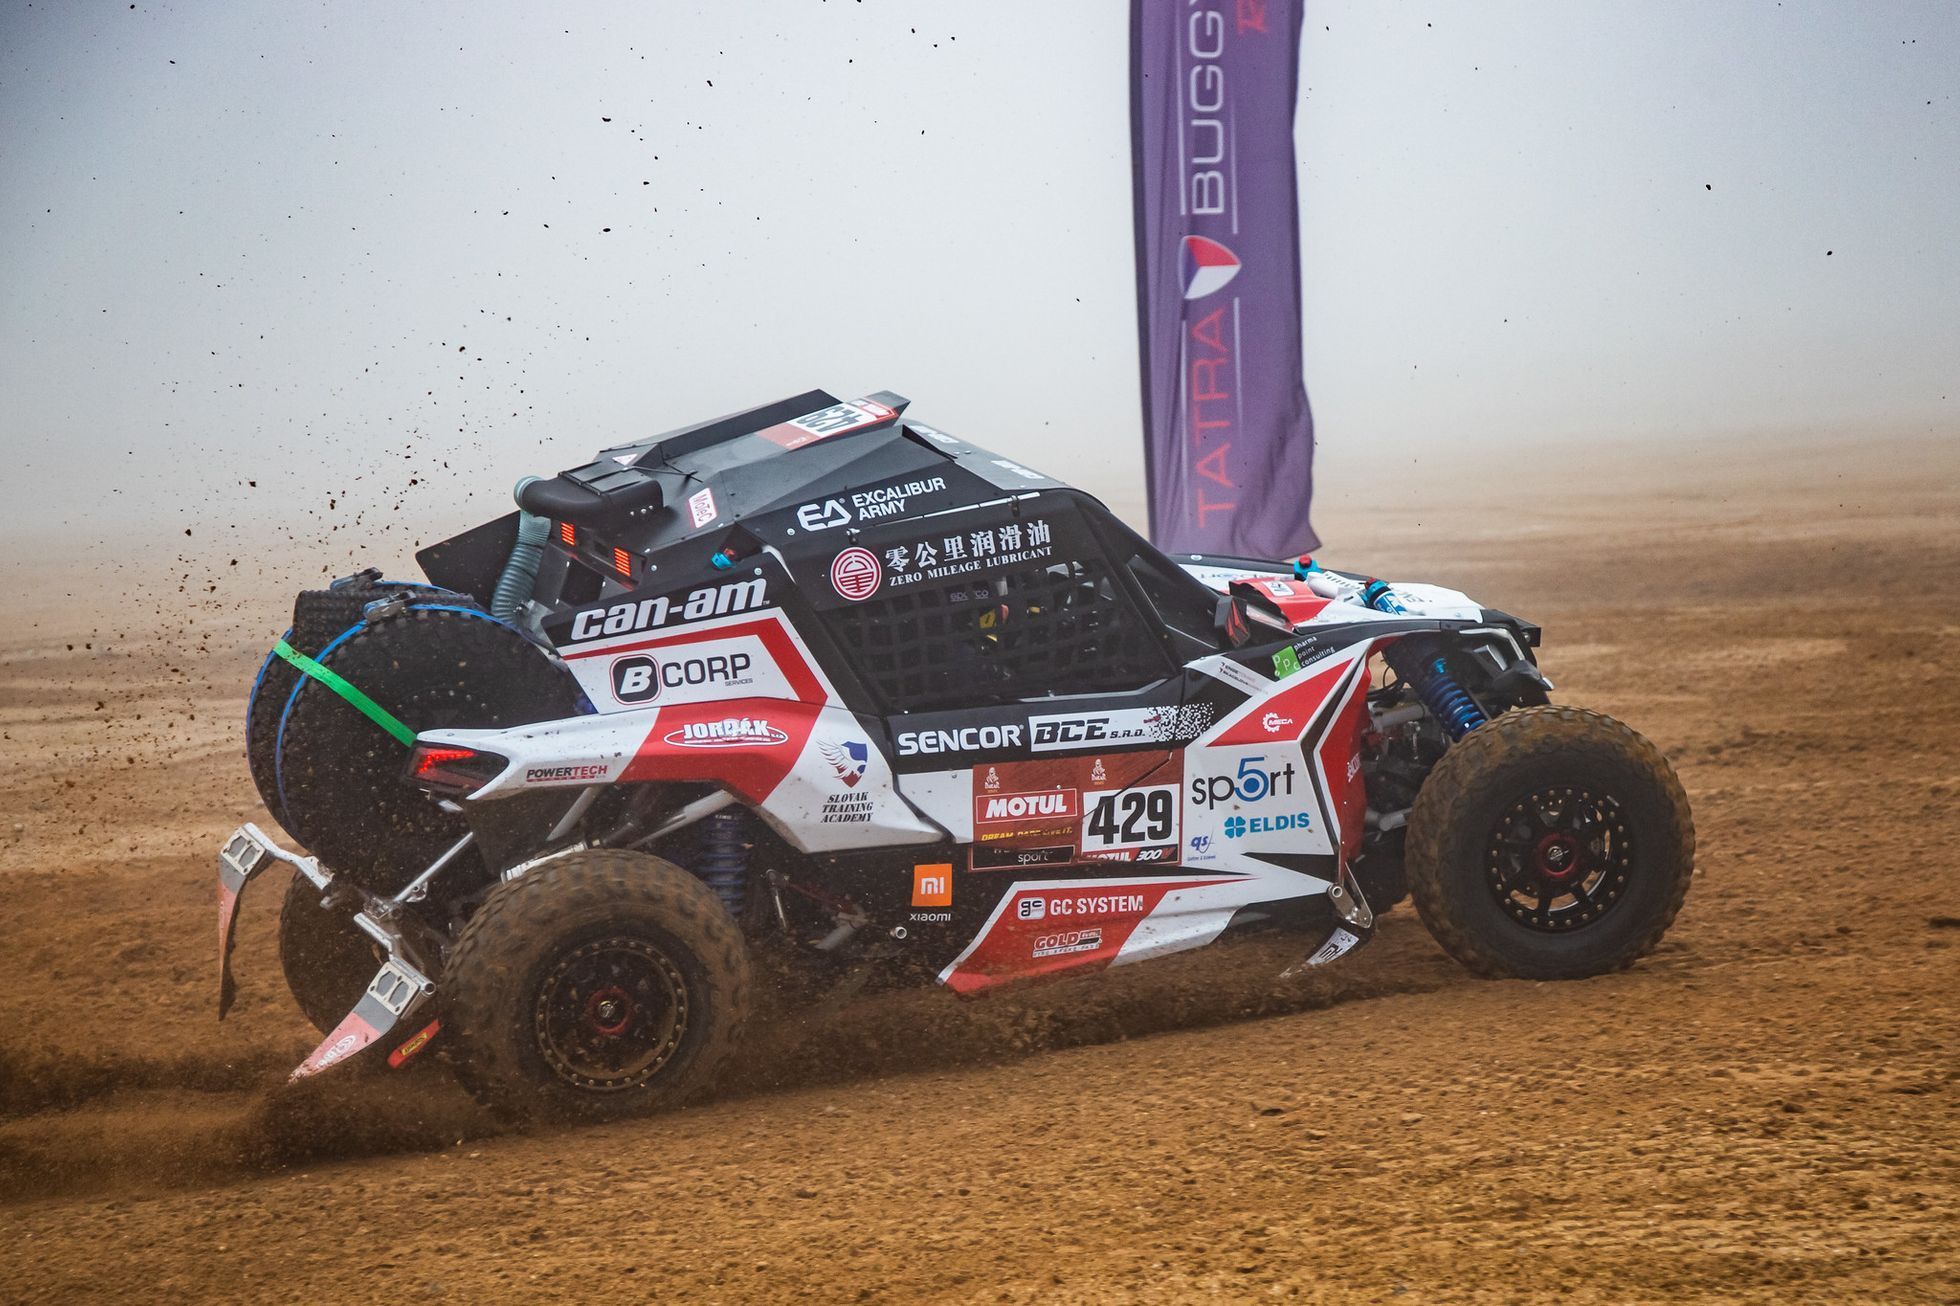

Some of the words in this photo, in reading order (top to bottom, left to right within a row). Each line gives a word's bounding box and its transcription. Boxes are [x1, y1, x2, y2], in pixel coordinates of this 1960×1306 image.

[1188, 0, 1224, 214] BUGG
[1191, 306, 1236, 529] TATRA
[852, 477, 947, 507] EXCALIBUR
[859, 499, 905, 521] ARMY
[885, 520, 1051, 572] 零公里润滑油
[889, 571, 922, 587] ZERO
[927, 560, 982, 580] MILEAGE
[986, 546, 1052, 568] LUBRICANT
[571, 578, 767, 641] can-am
[1294, 636, 1317, 651] pharma
[1297, 646, 1315, 660] point
[1301, 646, 1336, 667] consulting
[620, 665, 653, 695] B
[662, 653, 751, 688] CORP
[725, 678, 753, 687] SERVICES
[898, 725, 1021, 756] SENCOR
[1033, 718, 1110, 744] BCE
[526, 765, 608, 778] POWERTECH
[822, 802, 873, 813] TRAINING
[827, 792, 869, 803] SLOVAK
[985, 794, 1067, 818] MOTUL
[820, 812, 873, 823] ACADEMY
[1088, 790, 1172, 844] 429
[1249, 812, 1310, 833] ELDIS
[1050, 899, 1072, 915] GC
[1077, 895, 1143, 914] SYSTEM
[1034, 931, 1080, 950] GOLD
